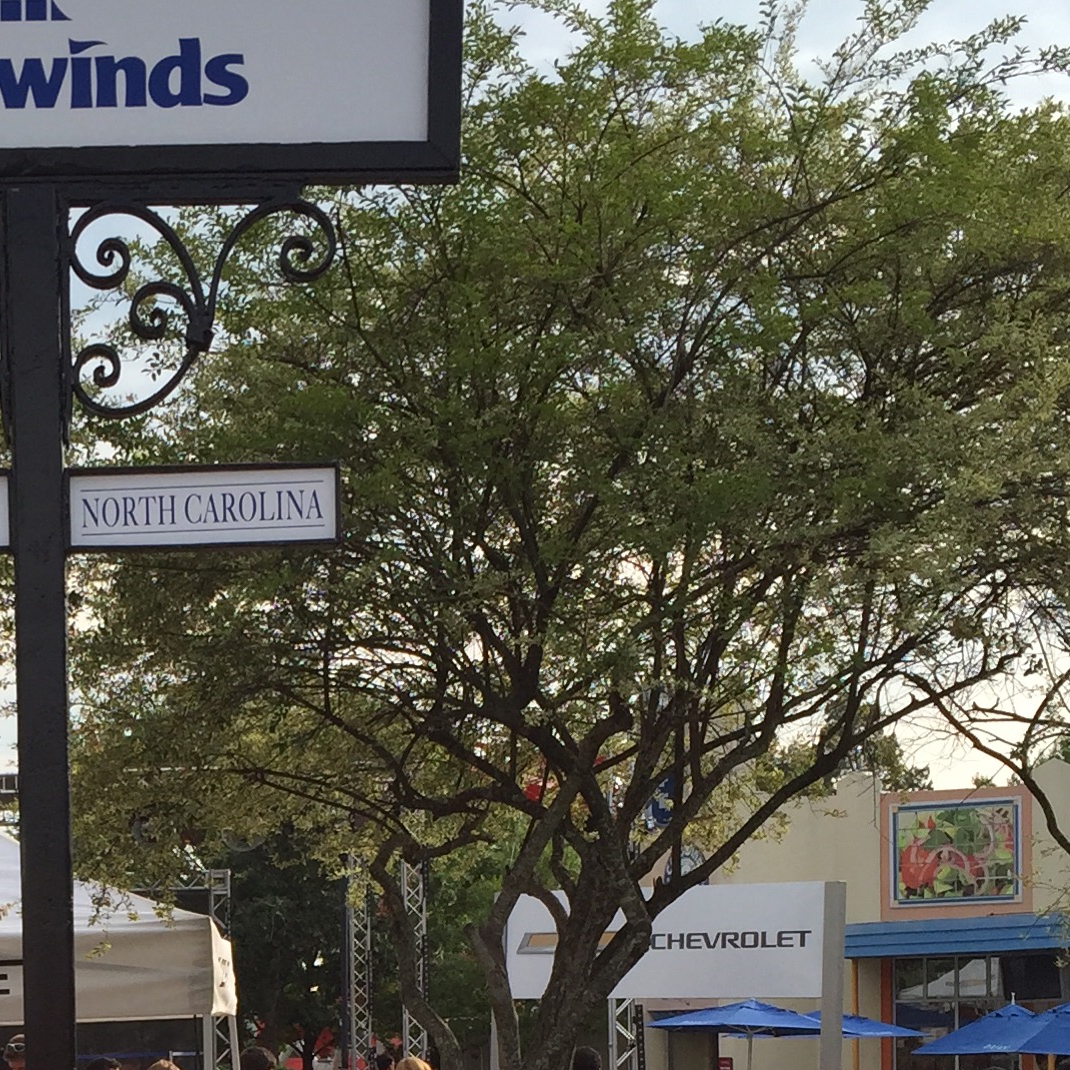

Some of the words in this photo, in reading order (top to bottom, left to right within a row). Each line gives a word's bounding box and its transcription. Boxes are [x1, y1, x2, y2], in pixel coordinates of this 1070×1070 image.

[81, 494, 177, 529] NORTH
[184, 489, 324, 525] CAROLINA
[651, 930, 812, 950] CHEVROLET
